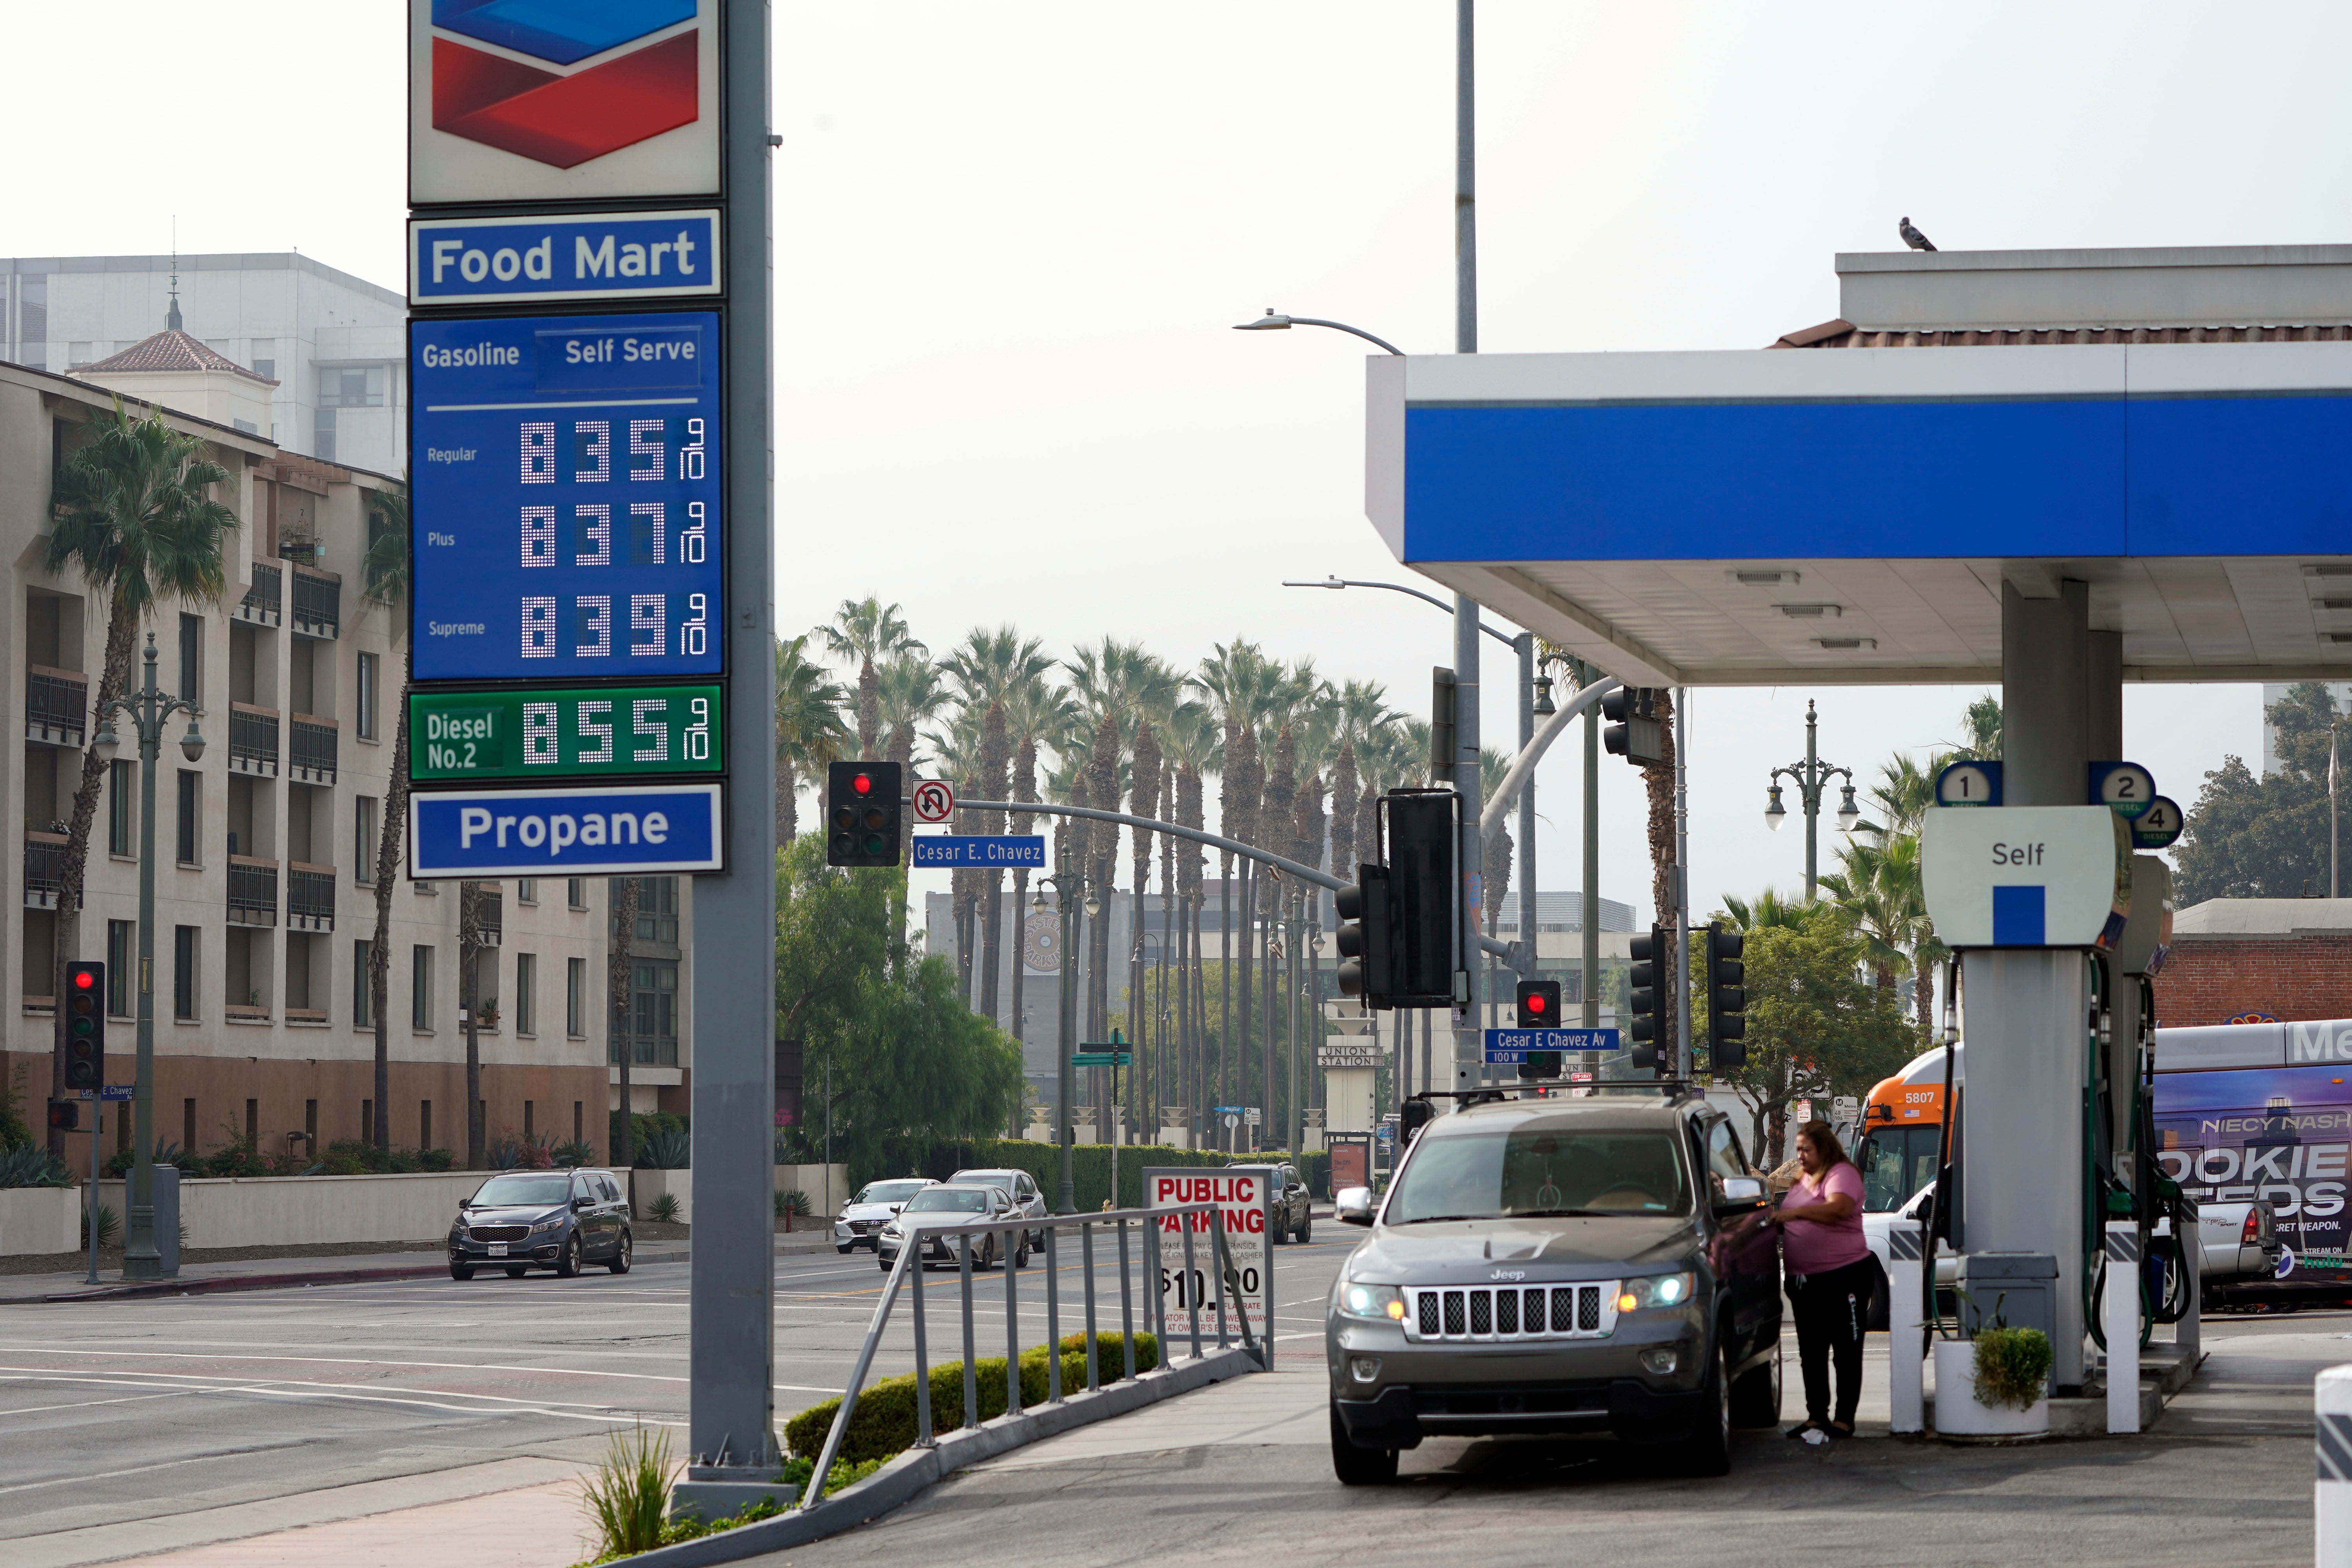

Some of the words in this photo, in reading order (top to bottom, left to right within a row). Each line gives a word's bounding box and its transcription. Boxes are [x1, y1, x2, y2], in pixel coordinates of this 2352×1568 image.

[432, 236, 552, 283] Food
[575, 230, 695, 279] Mart
[423, 342, 520, 368] Gasoline
[565, 338, 614, 364] Self
[623, 338, 696, 363] Serve
[427, 447, 477, 465] Regular
[521, 419, 665, 484] 835
[428, 532, 456, 547] Plus
[521, 503, 666, 568] 837
[428, 622, 486, 638] Supreme
[521, 594, 666, 658] 839
[427, 712, 493, 740] Diesel
[523, 699, 668, 765] 855
[428, 742, 477, 769] No.2
[1960, 776, 1969, 797] 1
[2118, 776, 2134, 798] 2
[2112, 802, 2141, 811] DIESEL
[2148, 808, 2165, 828] 4
[460, 807, 669, 857] Propane
[917, 843, 960, 860] Cesar
[968, 844, 982, 860] E.
[987, 843, 1041, 860] Chavez
[1992, 842, 2045, 866] Self
[1498, 1032, 1530, 1047] Cesar
[1535, 1032, 1543, 1046] E
[1548, 1032, 1588, 1047] Chavez
[1592, 1032, 1606, 1046] Av
[1321, 1057, 1371, 1065] STATION
[1325, 1047, 1367, 1055] UNION
[1494, 1052, 1509, 1062] 100
[1511, 1052, 1519, 1062] W
[103, 1087, 107, 1095] E
[110, 1087, 133, 1095] Chavez
[1906, 1092, 1934, 1104] 5807
[2201, 1117, 2276, 1134] NIECY
[2281, 1113, 2351, 1130] NASH
[2156, 1144, 2349, 1183] OOKIE
[1158, 1178, 1254, 1203] PUBLIC
[2298, 1221, 2341, 1232] WEAPON.
[2304, 1255, 2343, 1269] hulu
[1490, 1269, 1526, 1281] Jeep
[1206, 1314, 1216, 1323] BE
